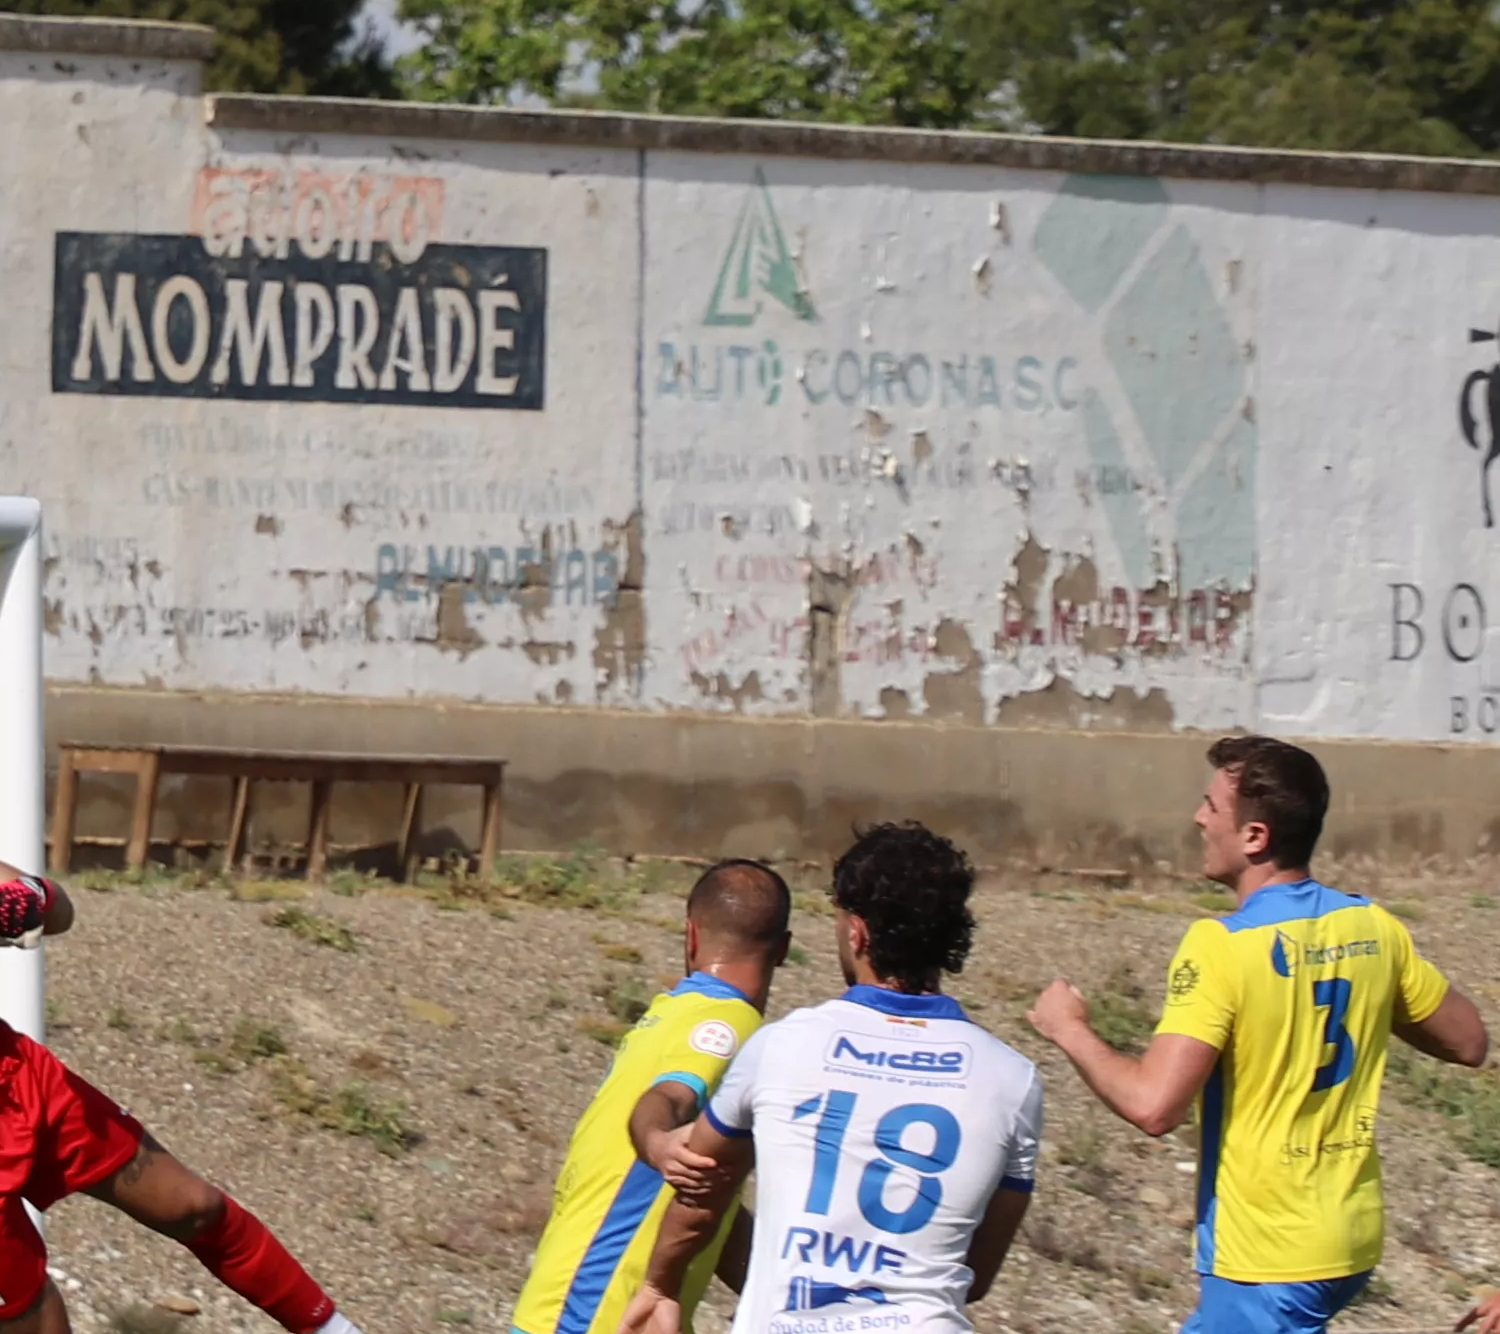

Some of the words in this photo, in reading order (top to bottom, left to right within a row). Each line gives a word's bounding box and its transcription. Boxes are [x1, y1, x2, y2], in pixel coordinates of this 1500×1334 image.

[70, 271, 521, 397] MOMPRADÉ
[1311, 976, 1356, 1094] 3
[791, 1089, 963, 1235] 18
[780, 1225, 908, 1275] RWE
[833, 1316, 857, 1333] de
[859, 1311, 912, 1331] Borja
